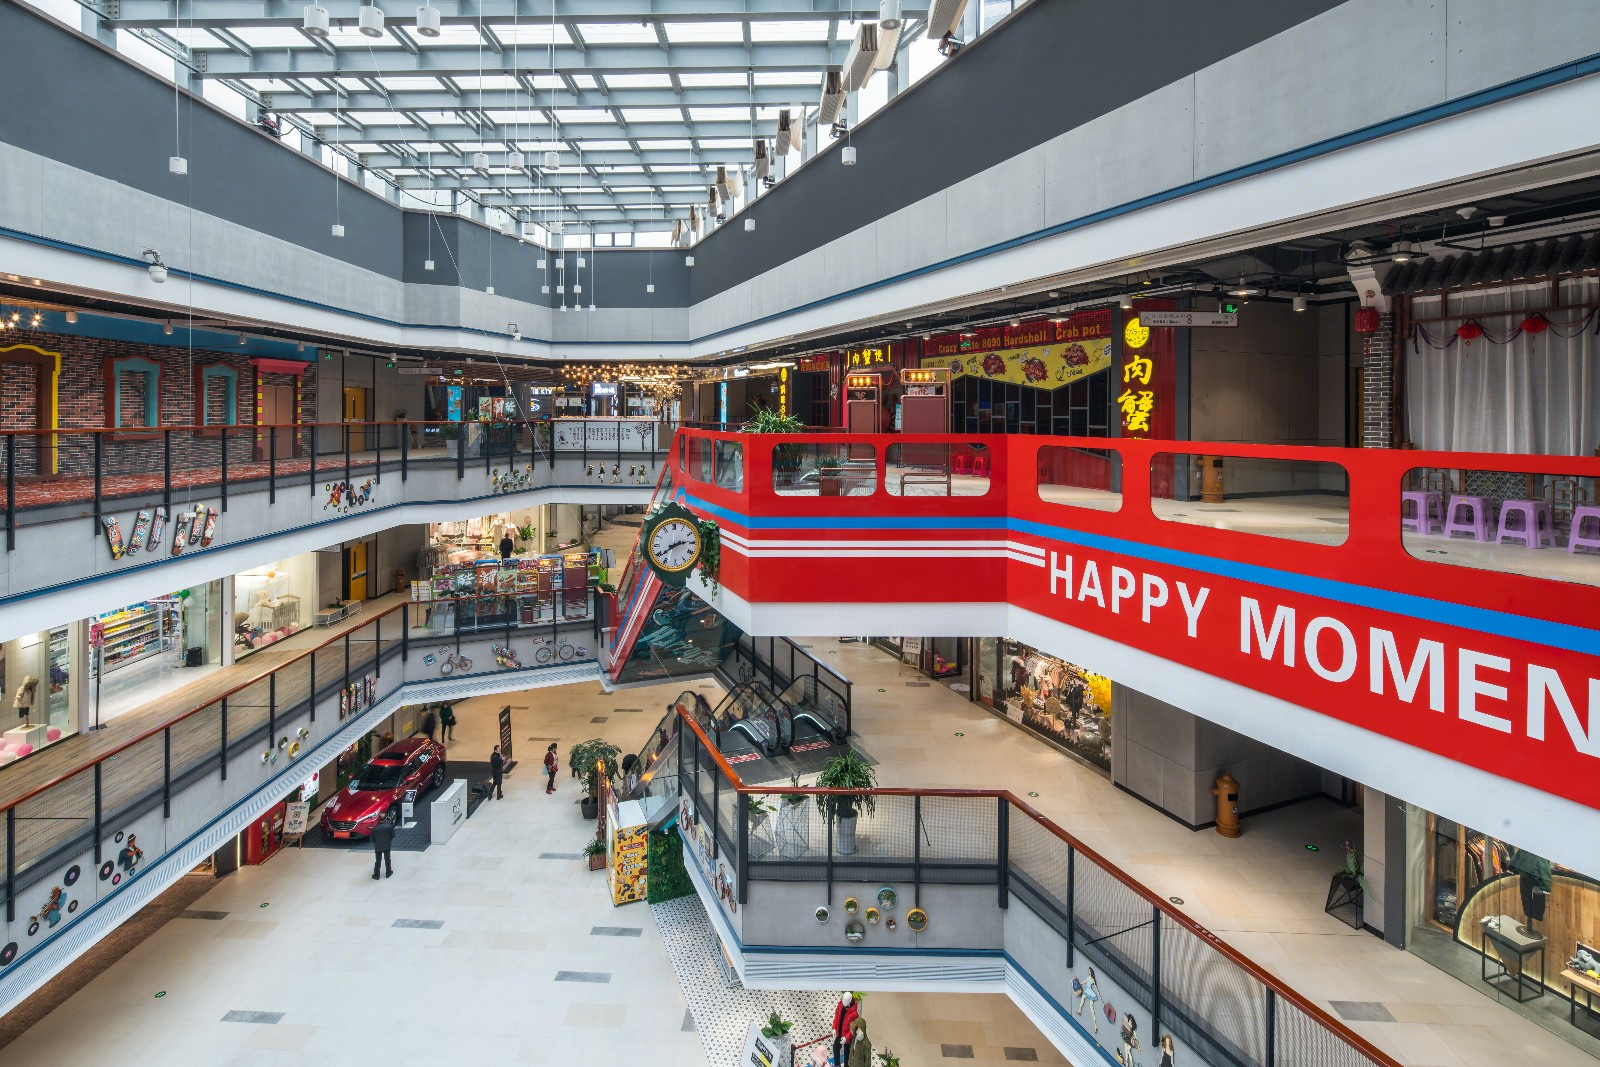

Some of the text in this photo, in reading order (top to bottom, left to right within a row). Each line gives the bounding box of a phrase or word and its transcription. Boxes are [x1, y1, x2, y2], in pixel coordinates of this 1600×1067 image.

[982, 337, 1001, 348] 8090
[1004, 330, 1047, 346] Hardshell
[1055, 327, 1079, 339] Crab
[1082, 324, 1101, 337] pot
[1049, 551, 1600, 758] HAPPY MOMEN
